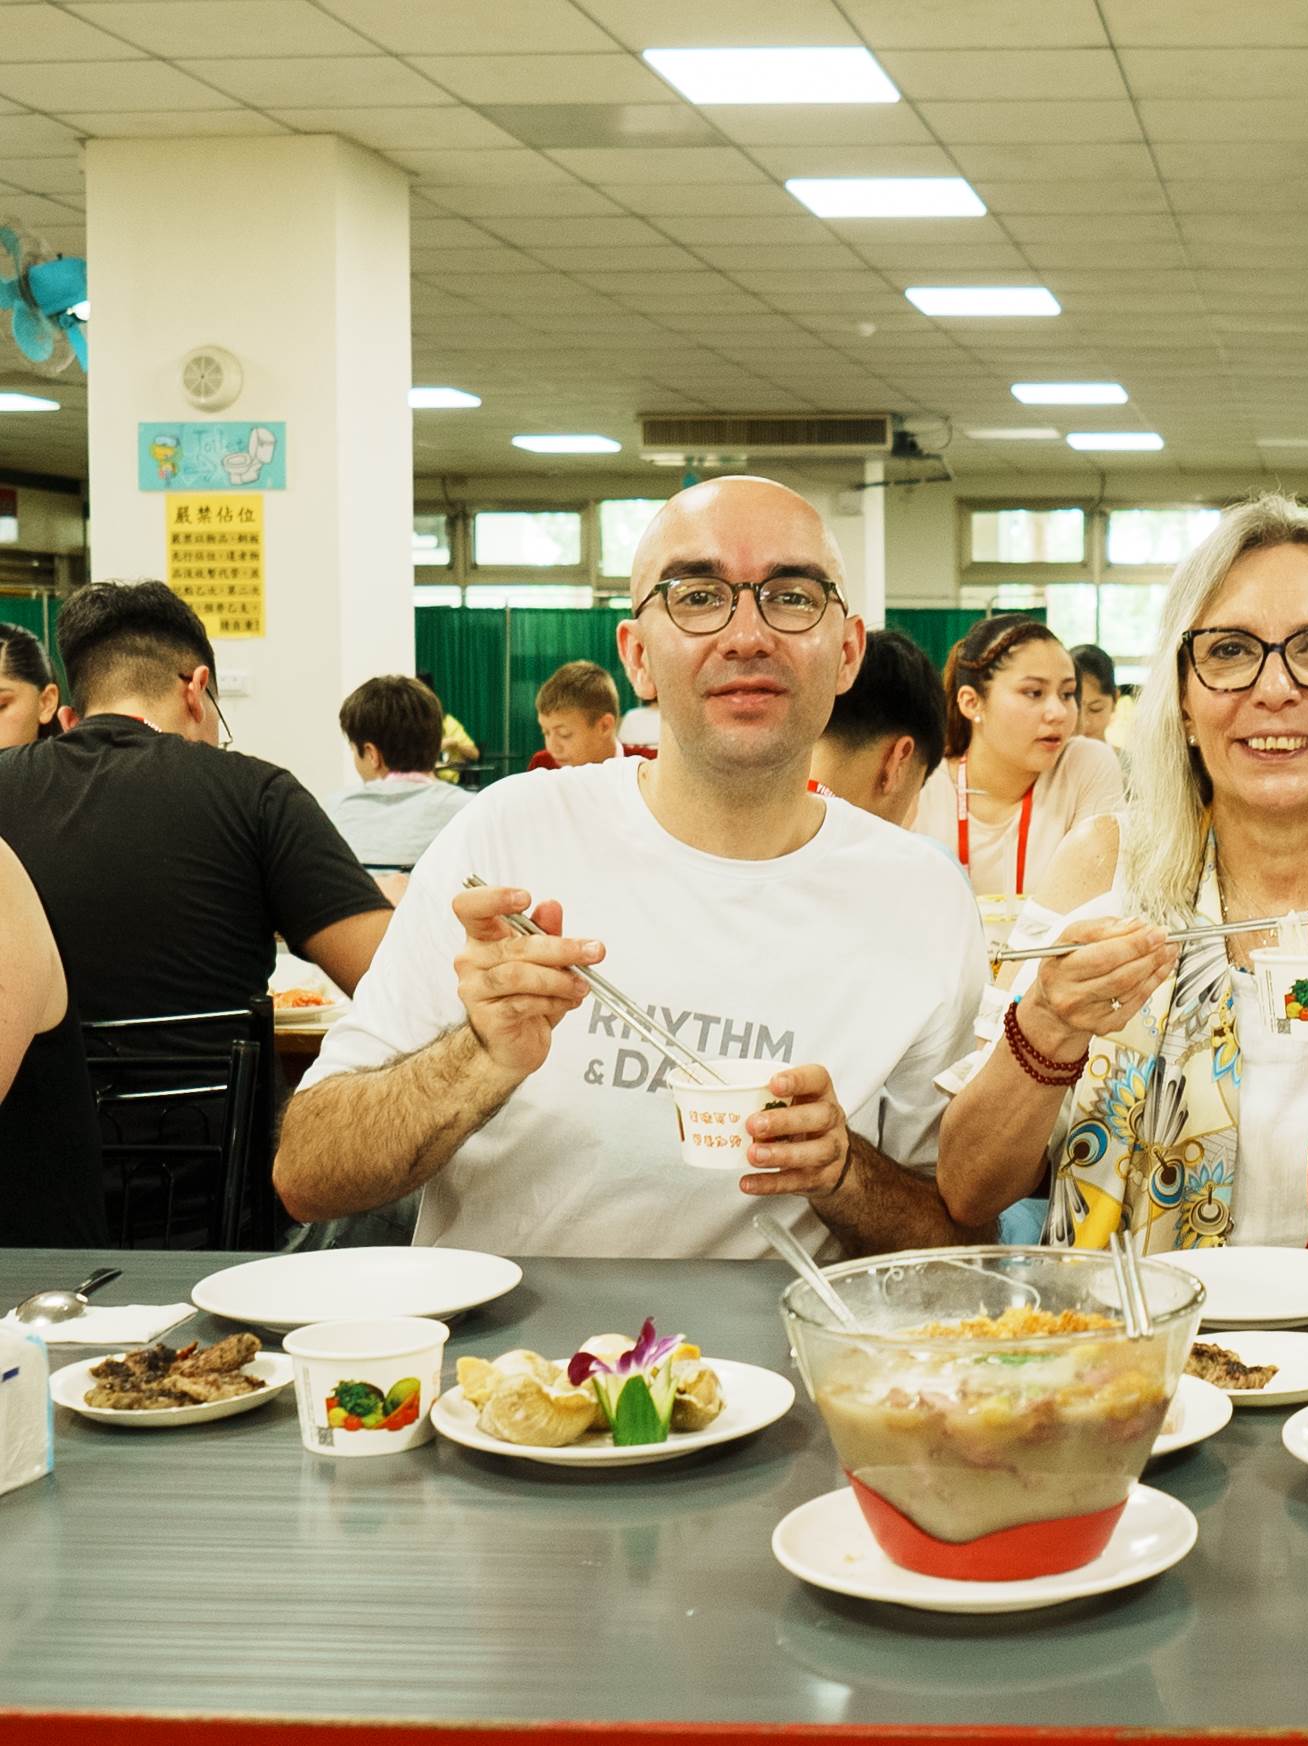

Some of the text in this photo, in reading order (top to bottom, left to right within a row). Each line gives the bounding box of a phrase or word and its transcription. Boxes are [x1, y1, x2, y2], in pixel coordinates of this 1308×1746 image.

[174, 505, 256, 524] 嚴禁佔位
[588, 998, 795, 1064] RHYTHM
[583, 1058, 605, 1086] &
